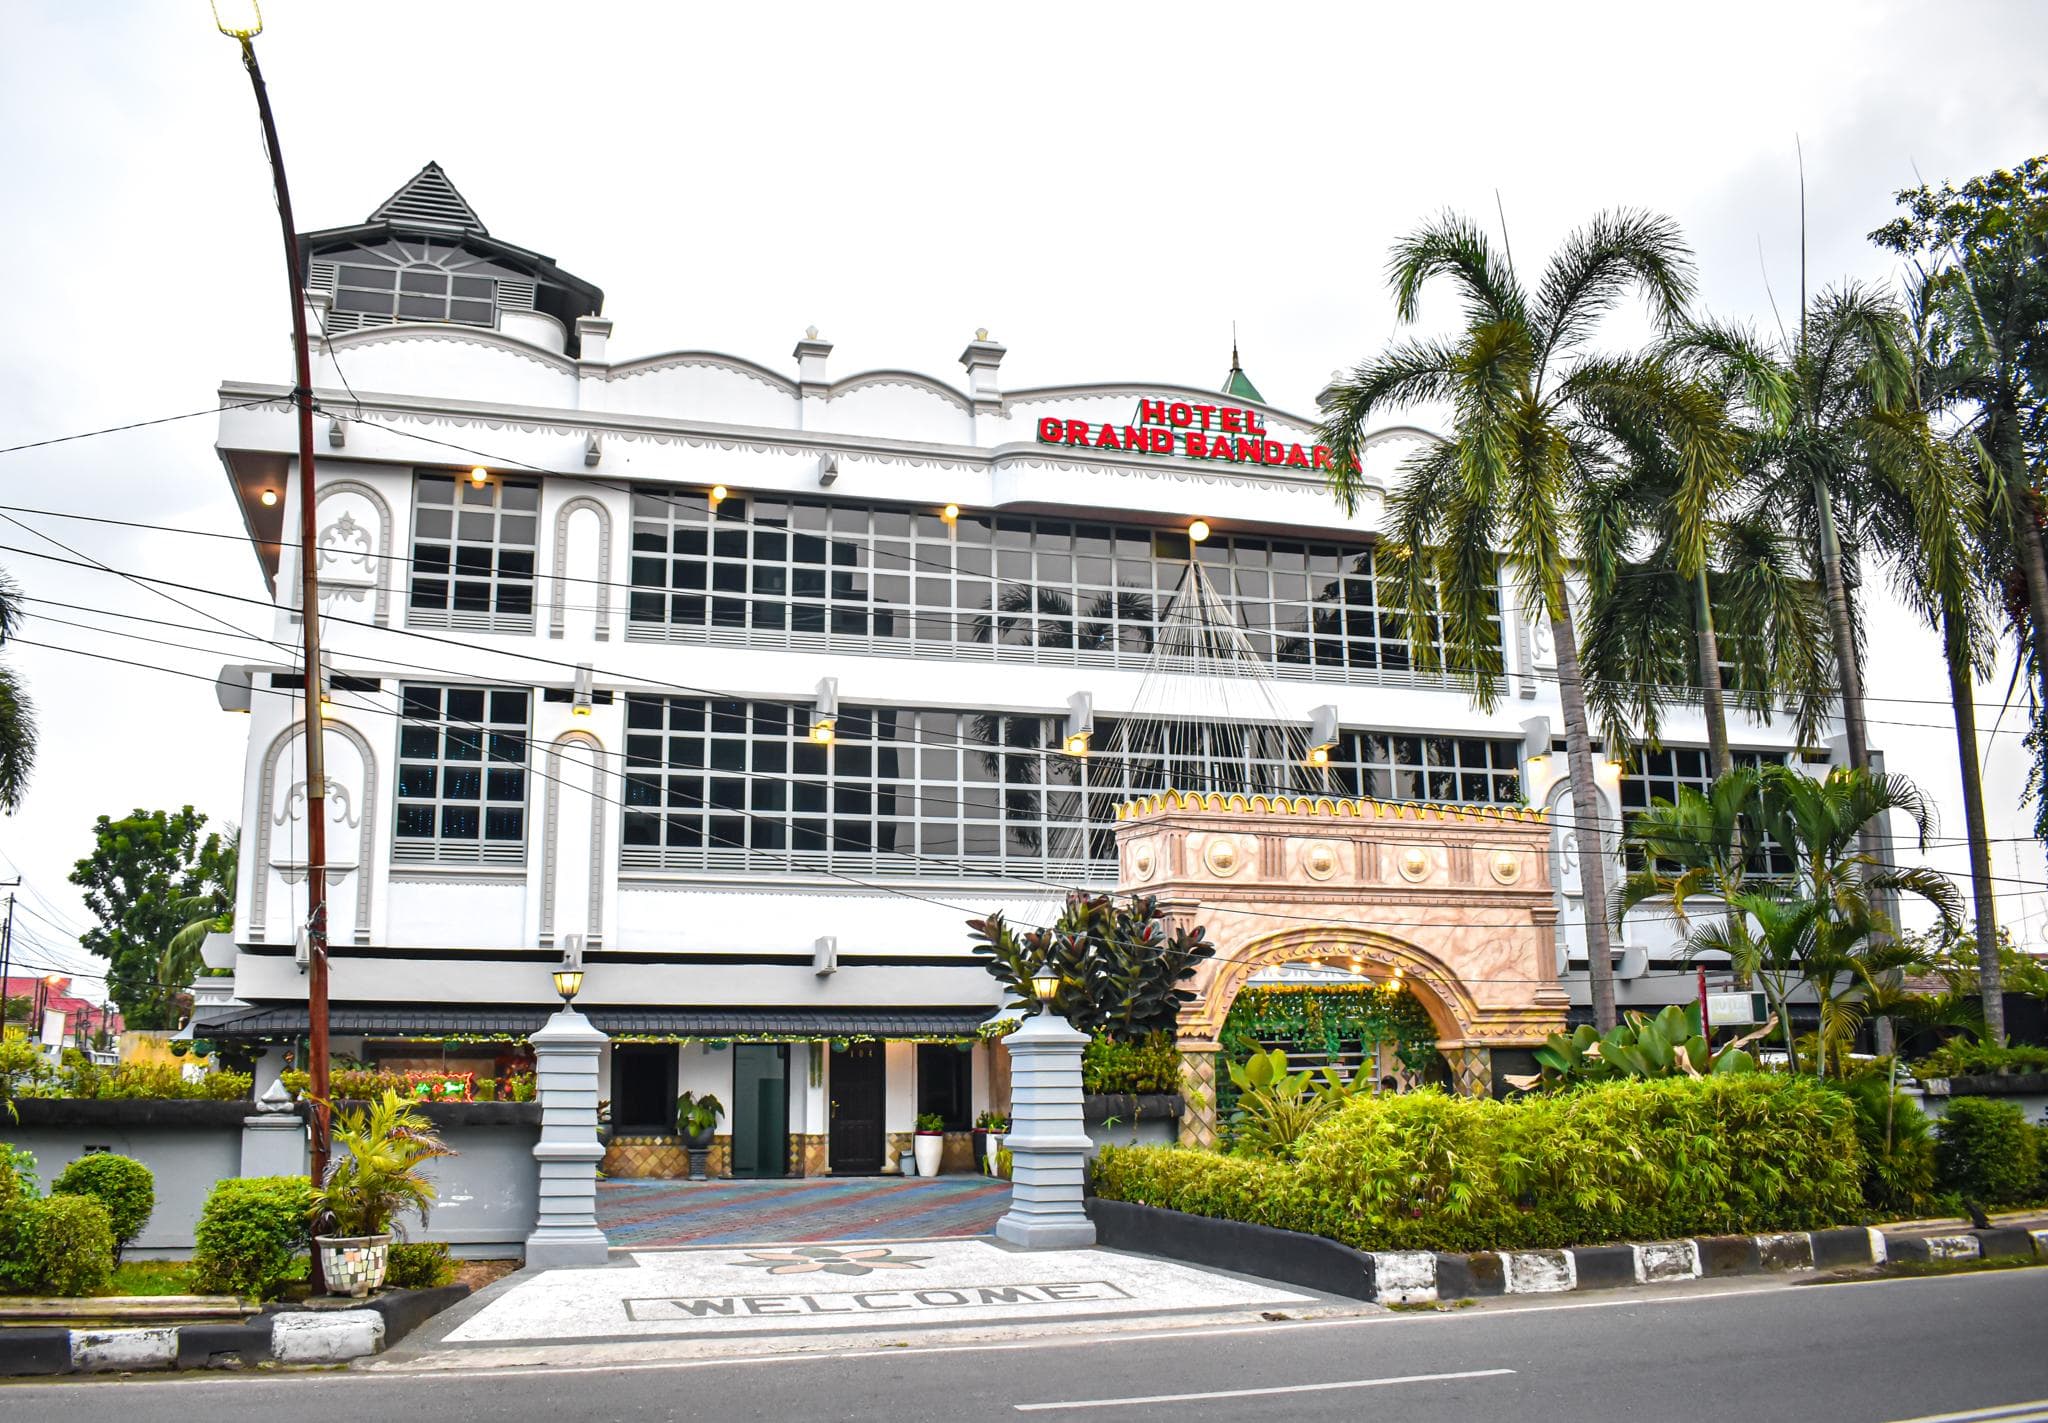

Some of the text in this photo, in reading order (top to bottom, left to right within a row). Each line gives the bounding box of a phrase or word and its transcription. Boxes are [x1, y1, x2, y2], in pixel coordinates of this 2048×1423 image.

[1038, 416, 1174, 453] GRAND
[1140, 399, 1267, 436] HOTEL
[671, 1285, 1099, 1316] WELCOME
